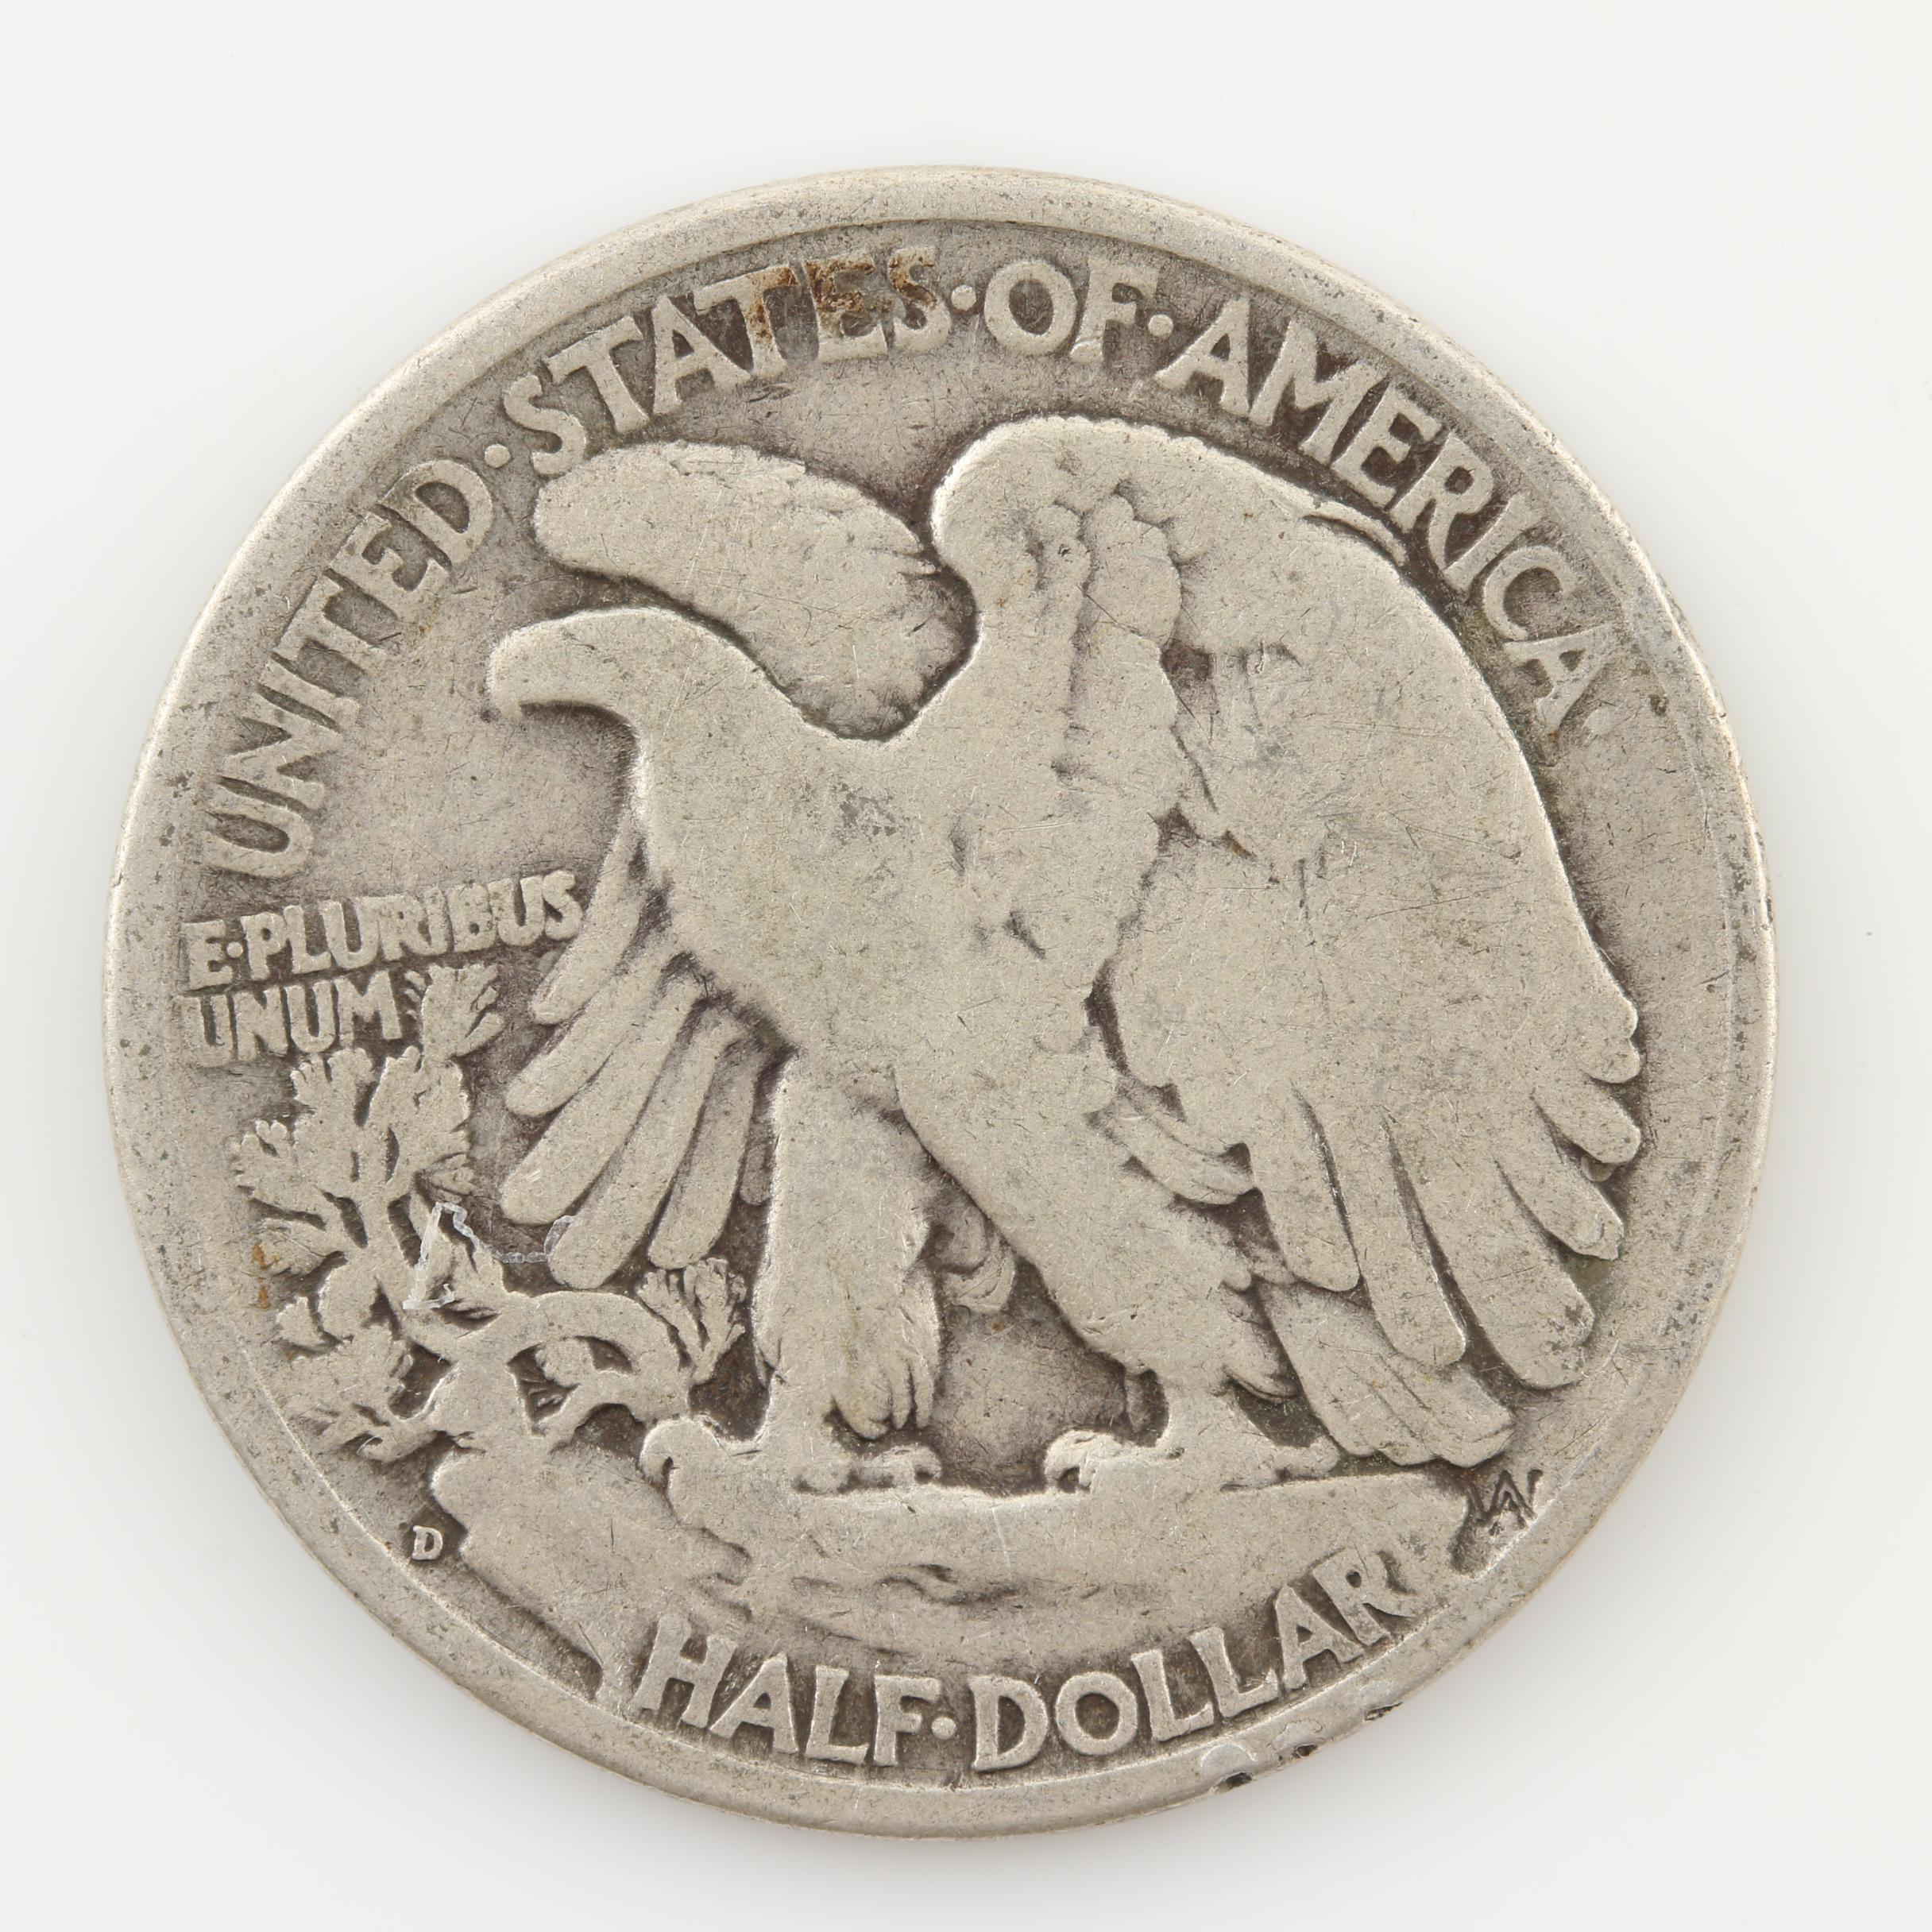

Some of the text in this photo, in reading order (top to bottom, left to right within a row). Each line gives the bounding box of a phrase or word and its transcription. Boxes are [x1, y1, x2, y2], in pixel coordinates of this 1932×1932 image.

[201, 246, 1616, 878] UNITED STATES OF AMERICA
[184, 970, 404, 1066] UNUM
[411, 1525, 443, 1563] D
[633, 1548, 1416, 1773] HALF DOLLAR
